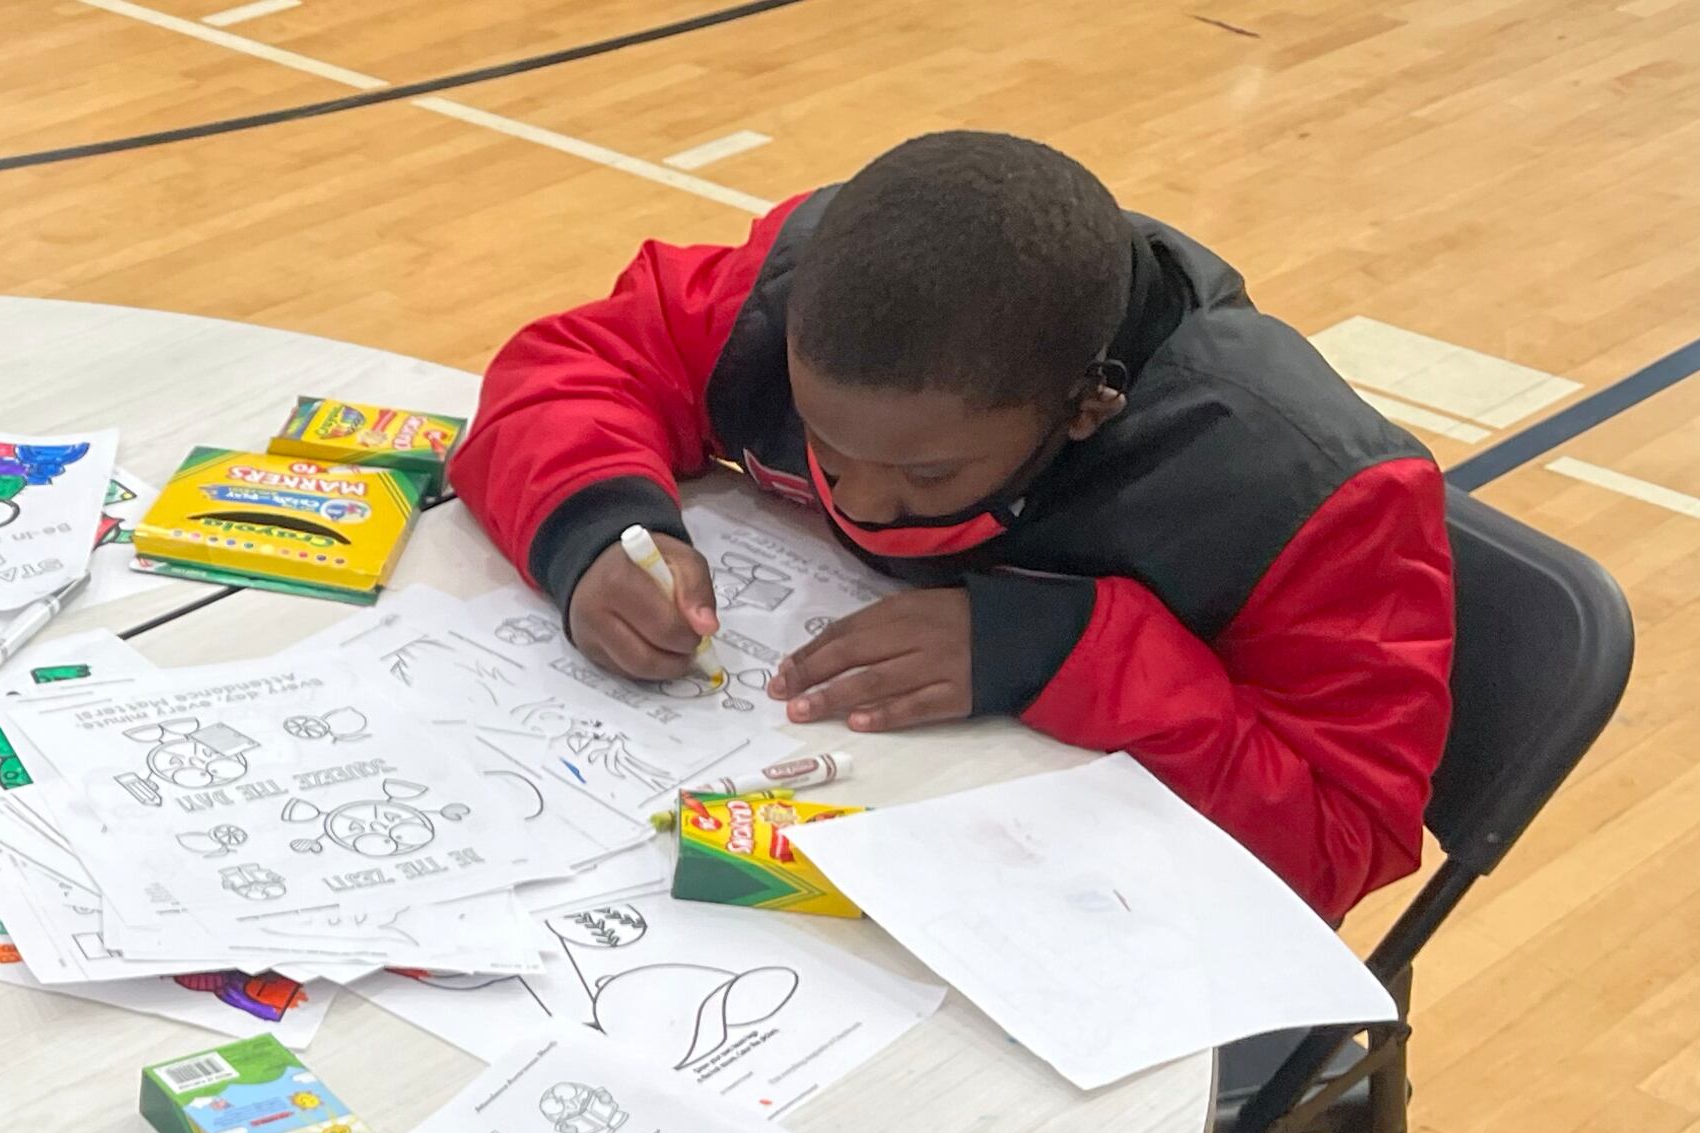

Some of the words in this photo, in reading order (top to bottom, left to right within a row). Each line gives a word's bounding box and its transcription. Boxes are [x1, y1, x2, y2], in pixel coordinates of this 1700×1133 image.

[229, 467, 367, 495] MARKERS
[291, 462, 319, 474] 10
[202, 517, 336, 547] Crayola
